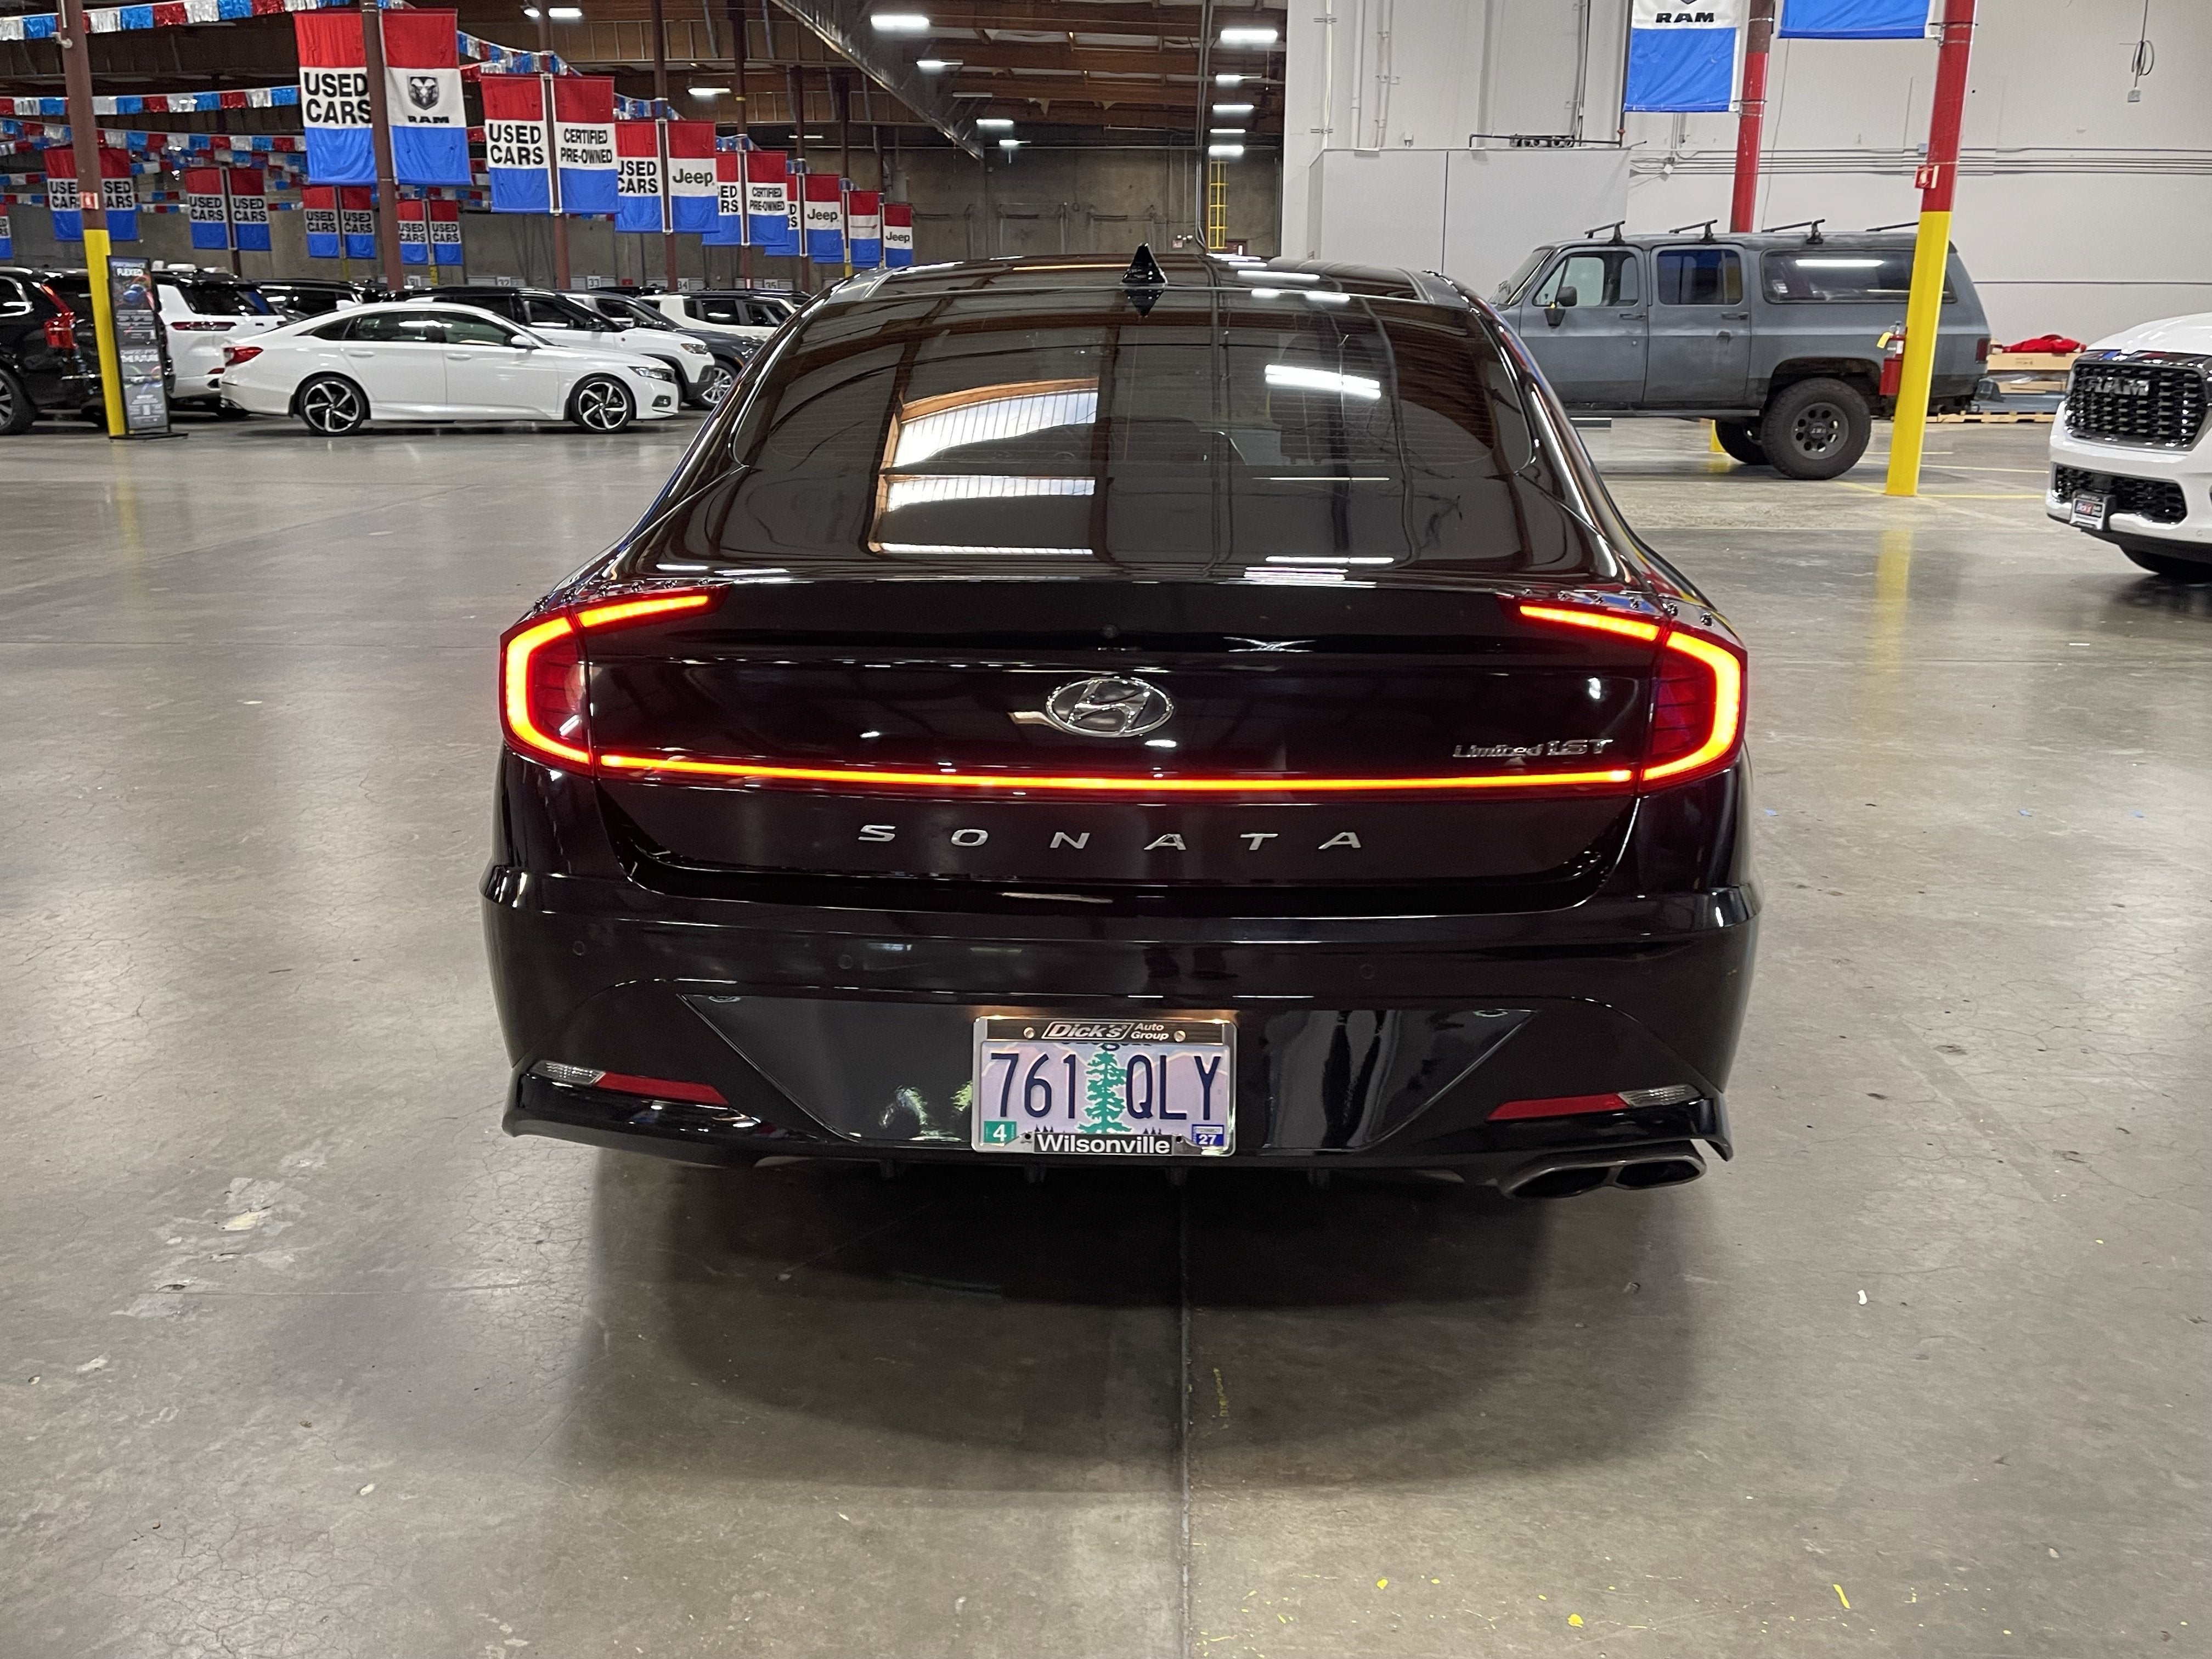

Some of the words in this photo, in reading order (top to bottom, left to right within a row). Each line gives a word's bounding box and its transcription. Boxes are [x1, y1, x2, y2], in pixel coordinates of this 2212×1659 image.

[1656, 13, 1714, 22] RAM
[304, 72, 368, 97] USED
[307, 99, 371, 124] CARS
[489, 123, 541, 144] USED
[564, 128, 607, 144] CERTIFIED
[490, 145, 544, 165] CARS
[561, 147, 612, 163] PRE-OWNED
[672, 168, 713, 187] Jeep
[50, 182, 77, 194] USE
[104, 182, 131, 193] SED
[618, 178, 658, 193] CARS
[720, 185, 737, 198] ED
[52, 196, 78, 208] CAR
[106, 196, 133, 208] ARS
[190, 197, 222, 208] USED
[233, 198, 263, 209] USED
[721, 200, 738, 212] RS
[191, 210, 224, 221] CARS
[234, 211, 267, 222] CARS
[307, 212, 334, 221] USED
[344, 213, 370, 222] USED
[807, 209, 838, 222] Jeep
[308, 223, 336, 233] CARS
[344, 223, 373, 233] CARS
[399, 223, 424, 232] USED
[432, 223, 458, 232] USED
[399, 233, 426, 242] CARS
[433, 234, 459, 242] CARS
[886, 232, 910, 243] Jeep
[1452, 744, 1543, 757] Limited
[859, 825, 1362, 850] SONATA
[1048, 1024, 1123, 1037] Dick's
[1135, 1023, 1164, 1031] Auto
[1131, 1031, 1169, 1041] Group
[991, 1053, 1076, 1119] 761
[1126, 1054, 1221, 1120] QLY
[993, 1124, 1007, 1141] 4
[1037, 1135, 1170, 1153] Wilsonville
[1199, 1134, 1216, 1145] 27
